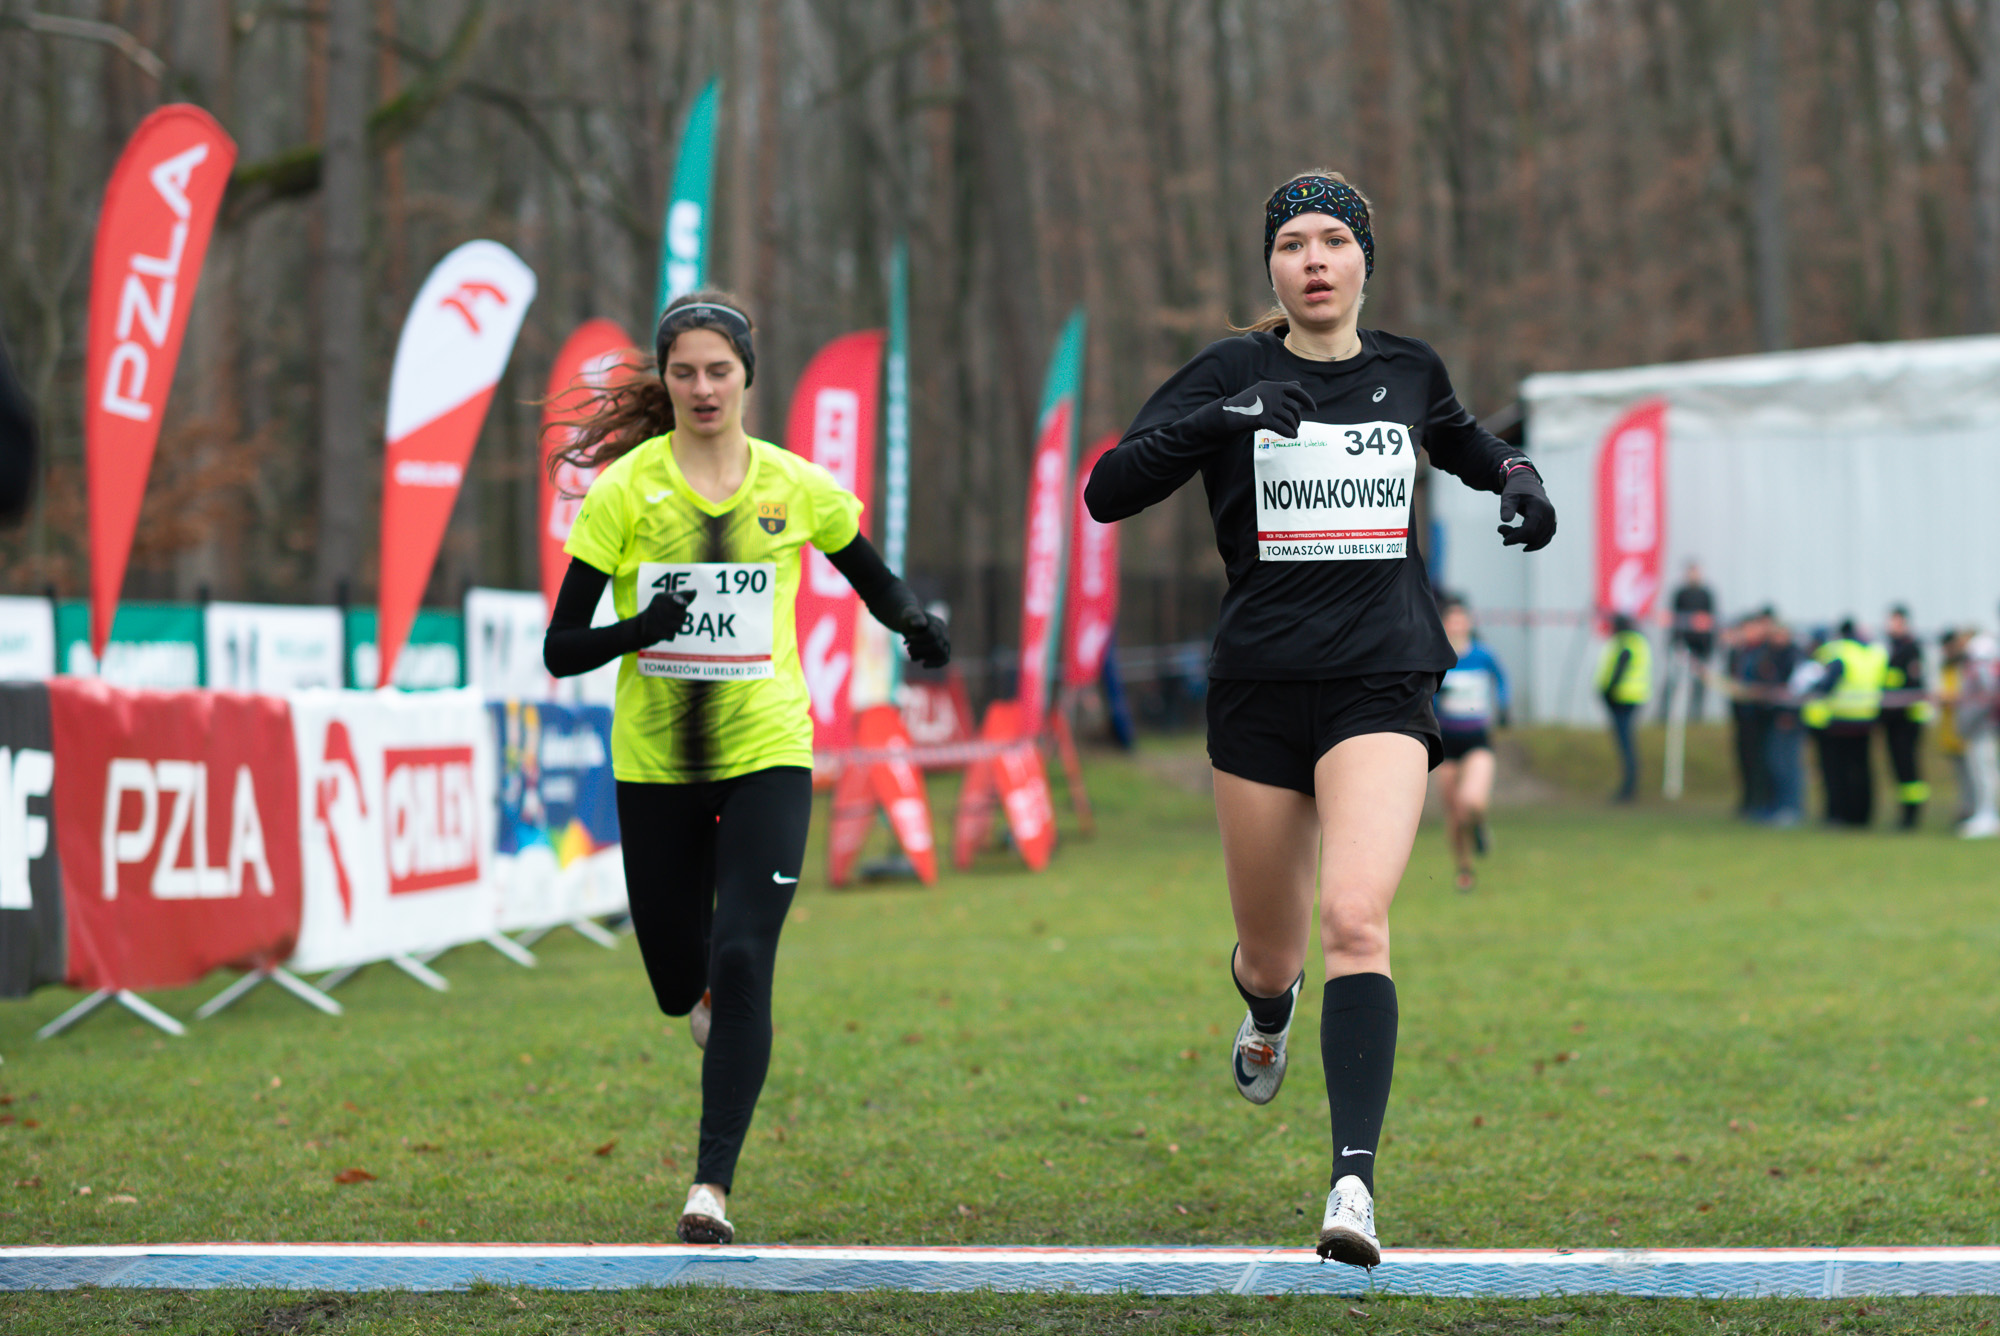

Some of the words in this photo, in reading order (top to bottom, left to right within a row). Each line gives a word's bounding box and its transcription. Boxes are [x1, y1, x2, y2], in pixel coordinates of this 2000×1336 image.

[102, 143, 209, 423] PZLA
[1344, 427, 1403, 456] 349
[1263, 477, 1406, 510] NOWAKOWSKA
[1266, 542, 1335, 556] TOMASZÓW
[1339, 543, 1384, 555] LUBELSKI
[1386, 542, 1403, 554] 2021
[651, 572, 692, 592] 4F
[715, 569, 768, 595] 190
[677, 612, 736, 643] BĄK
[643, 662, 701, 676] TOMASZÓW
[703, 666, 745, 677] LUBELSKI
[746, 666, 769, 676] 2021
[102, 756, 275, 902] PZLA
